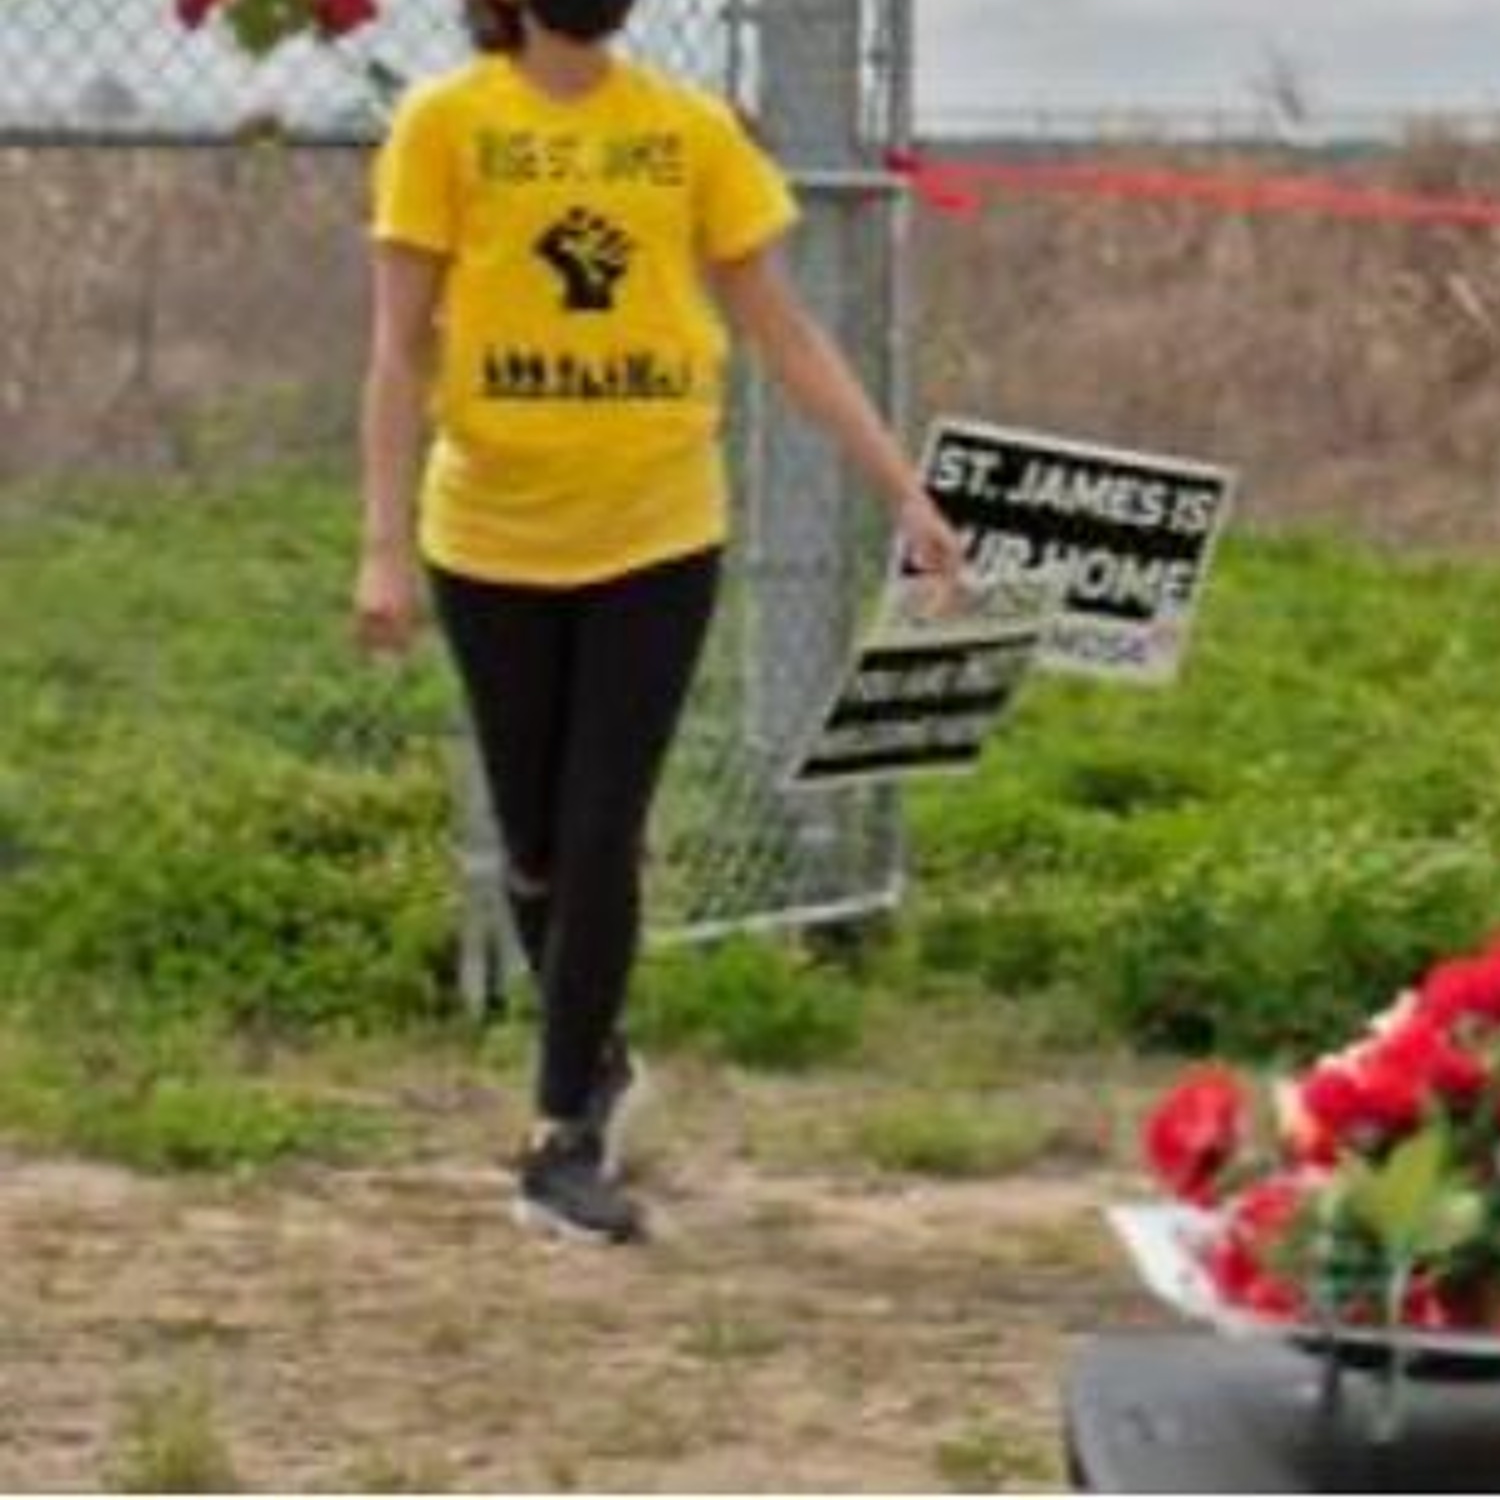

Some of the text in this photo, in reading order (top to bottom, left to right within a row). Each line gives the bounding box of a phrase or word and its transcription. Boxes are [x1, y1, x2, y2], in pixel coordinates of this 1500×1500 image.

[935, 446, 1218, 532] ST. JAMES IS
[1034, 544, 1196, 614] HOME
